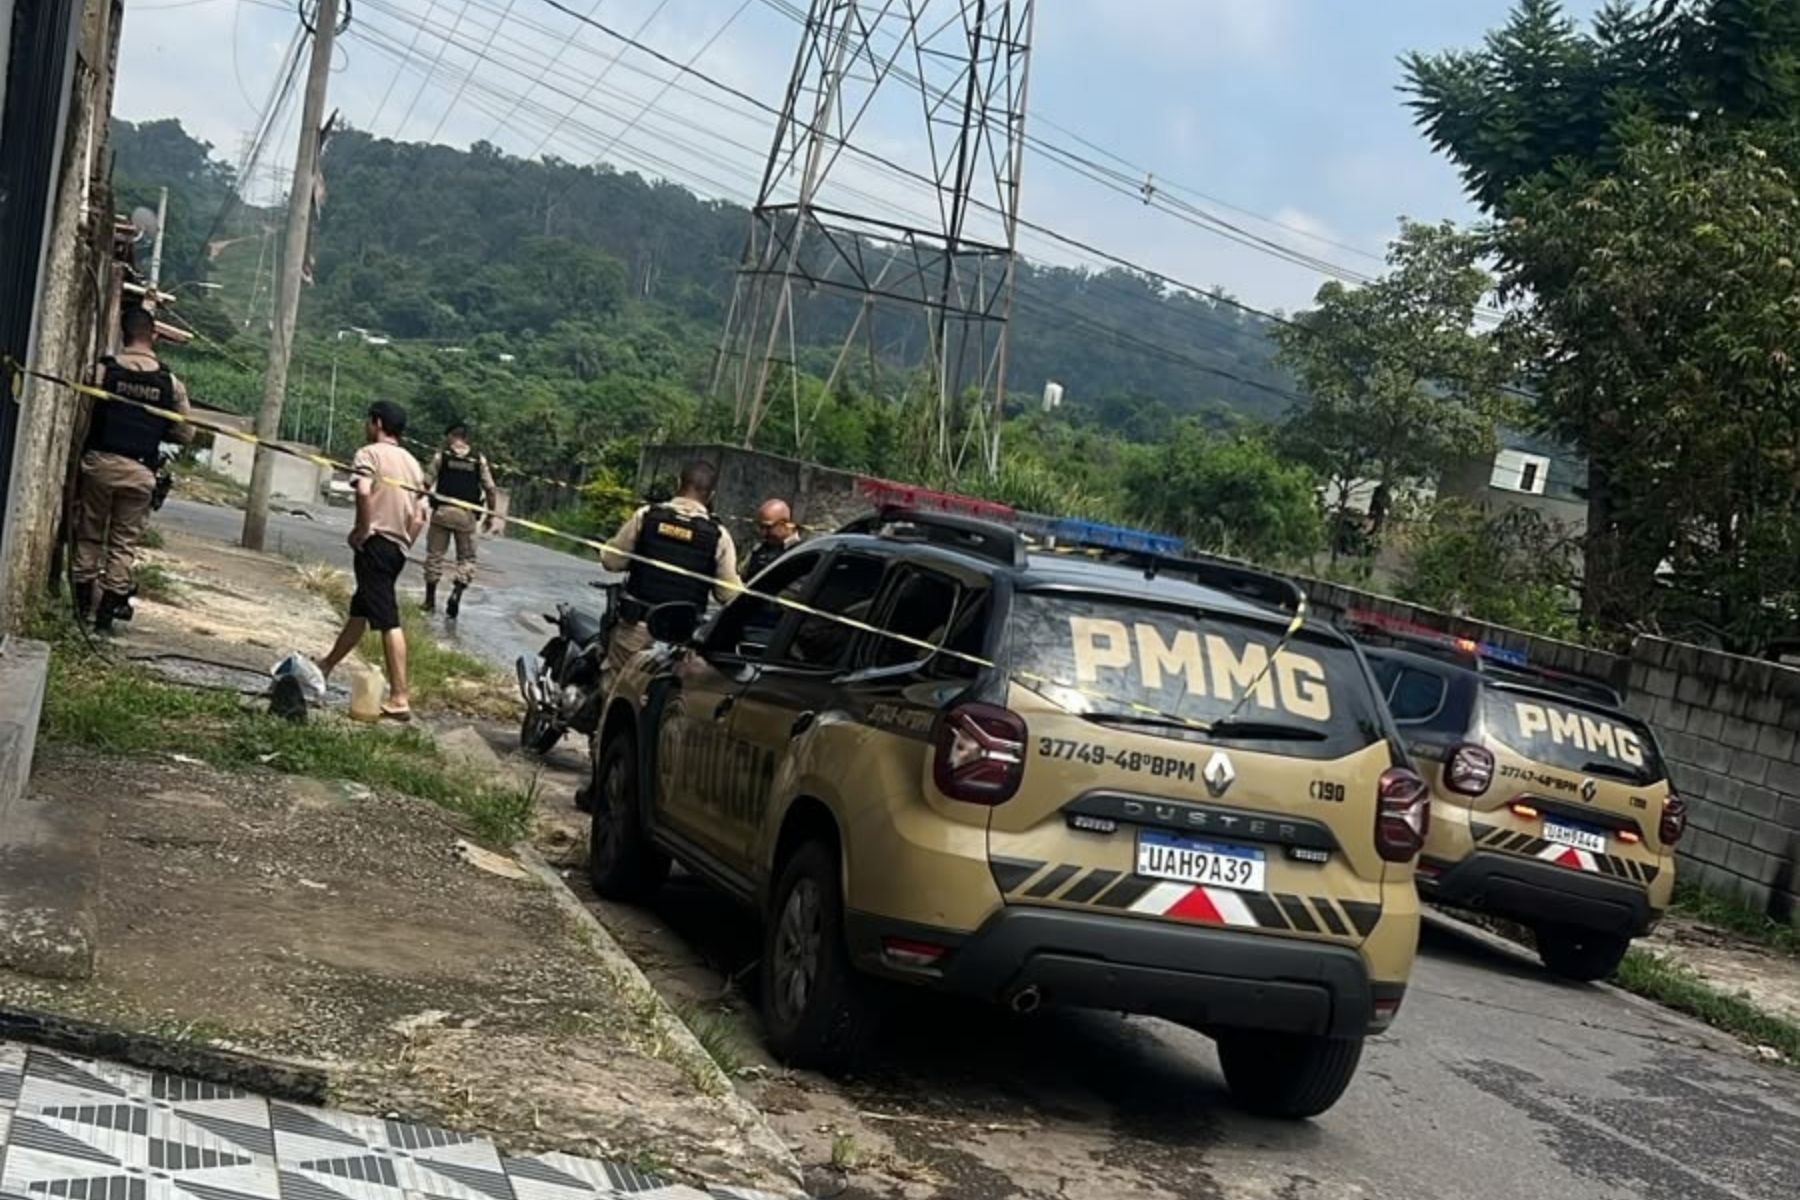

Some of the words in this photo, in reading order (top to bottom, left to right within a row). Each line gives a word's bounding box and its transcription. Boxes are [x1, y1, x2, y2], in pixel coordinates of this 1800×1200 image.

[116, 381, 161, 401] PMMG
[1069, 616, 1331, 722] PMMG
[1515, 703, 1644, 766] PMMG
[1123, 801, 1296, 838] DUSTER
[1149, 847, 1253, 884] UAH9A39
